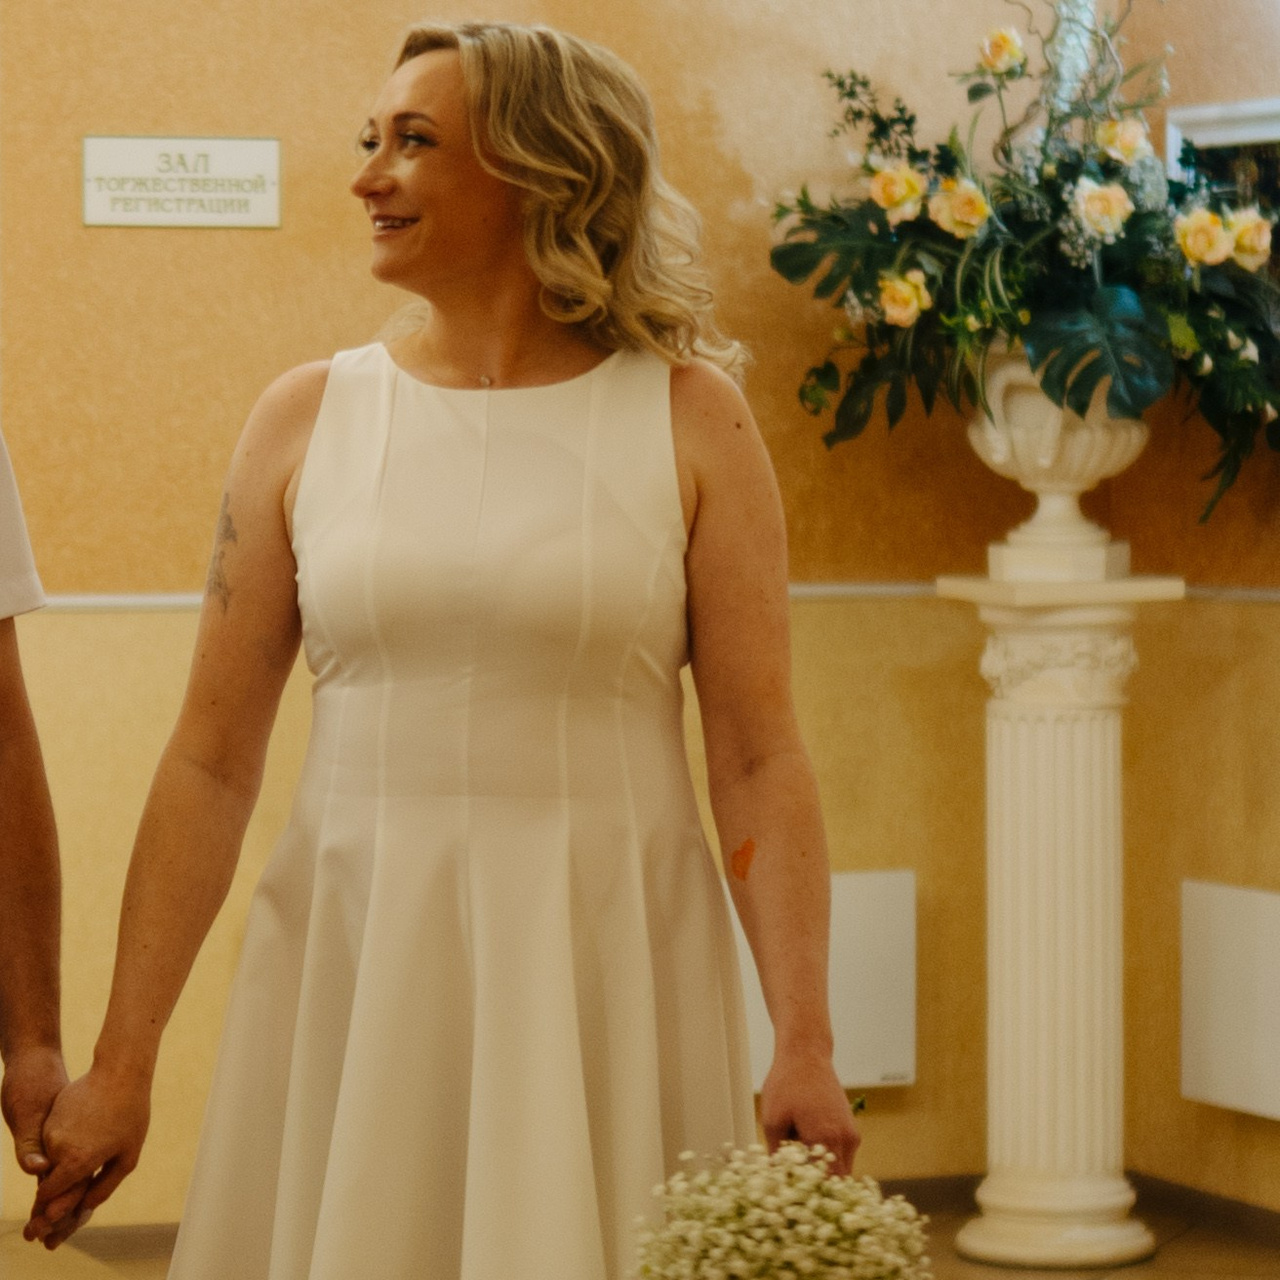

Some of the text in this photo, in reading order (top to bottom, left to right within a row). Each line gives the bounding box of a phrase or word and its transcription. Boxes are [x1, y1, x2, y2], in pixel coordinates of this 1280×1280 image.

[156, 152, 210, 174] ЗАЛ
[94, 174, 267, 194] ТОРЖЕСТВЕННОЙ
[109, 196, 251, 214] РЕГИСТРАЦИИ
